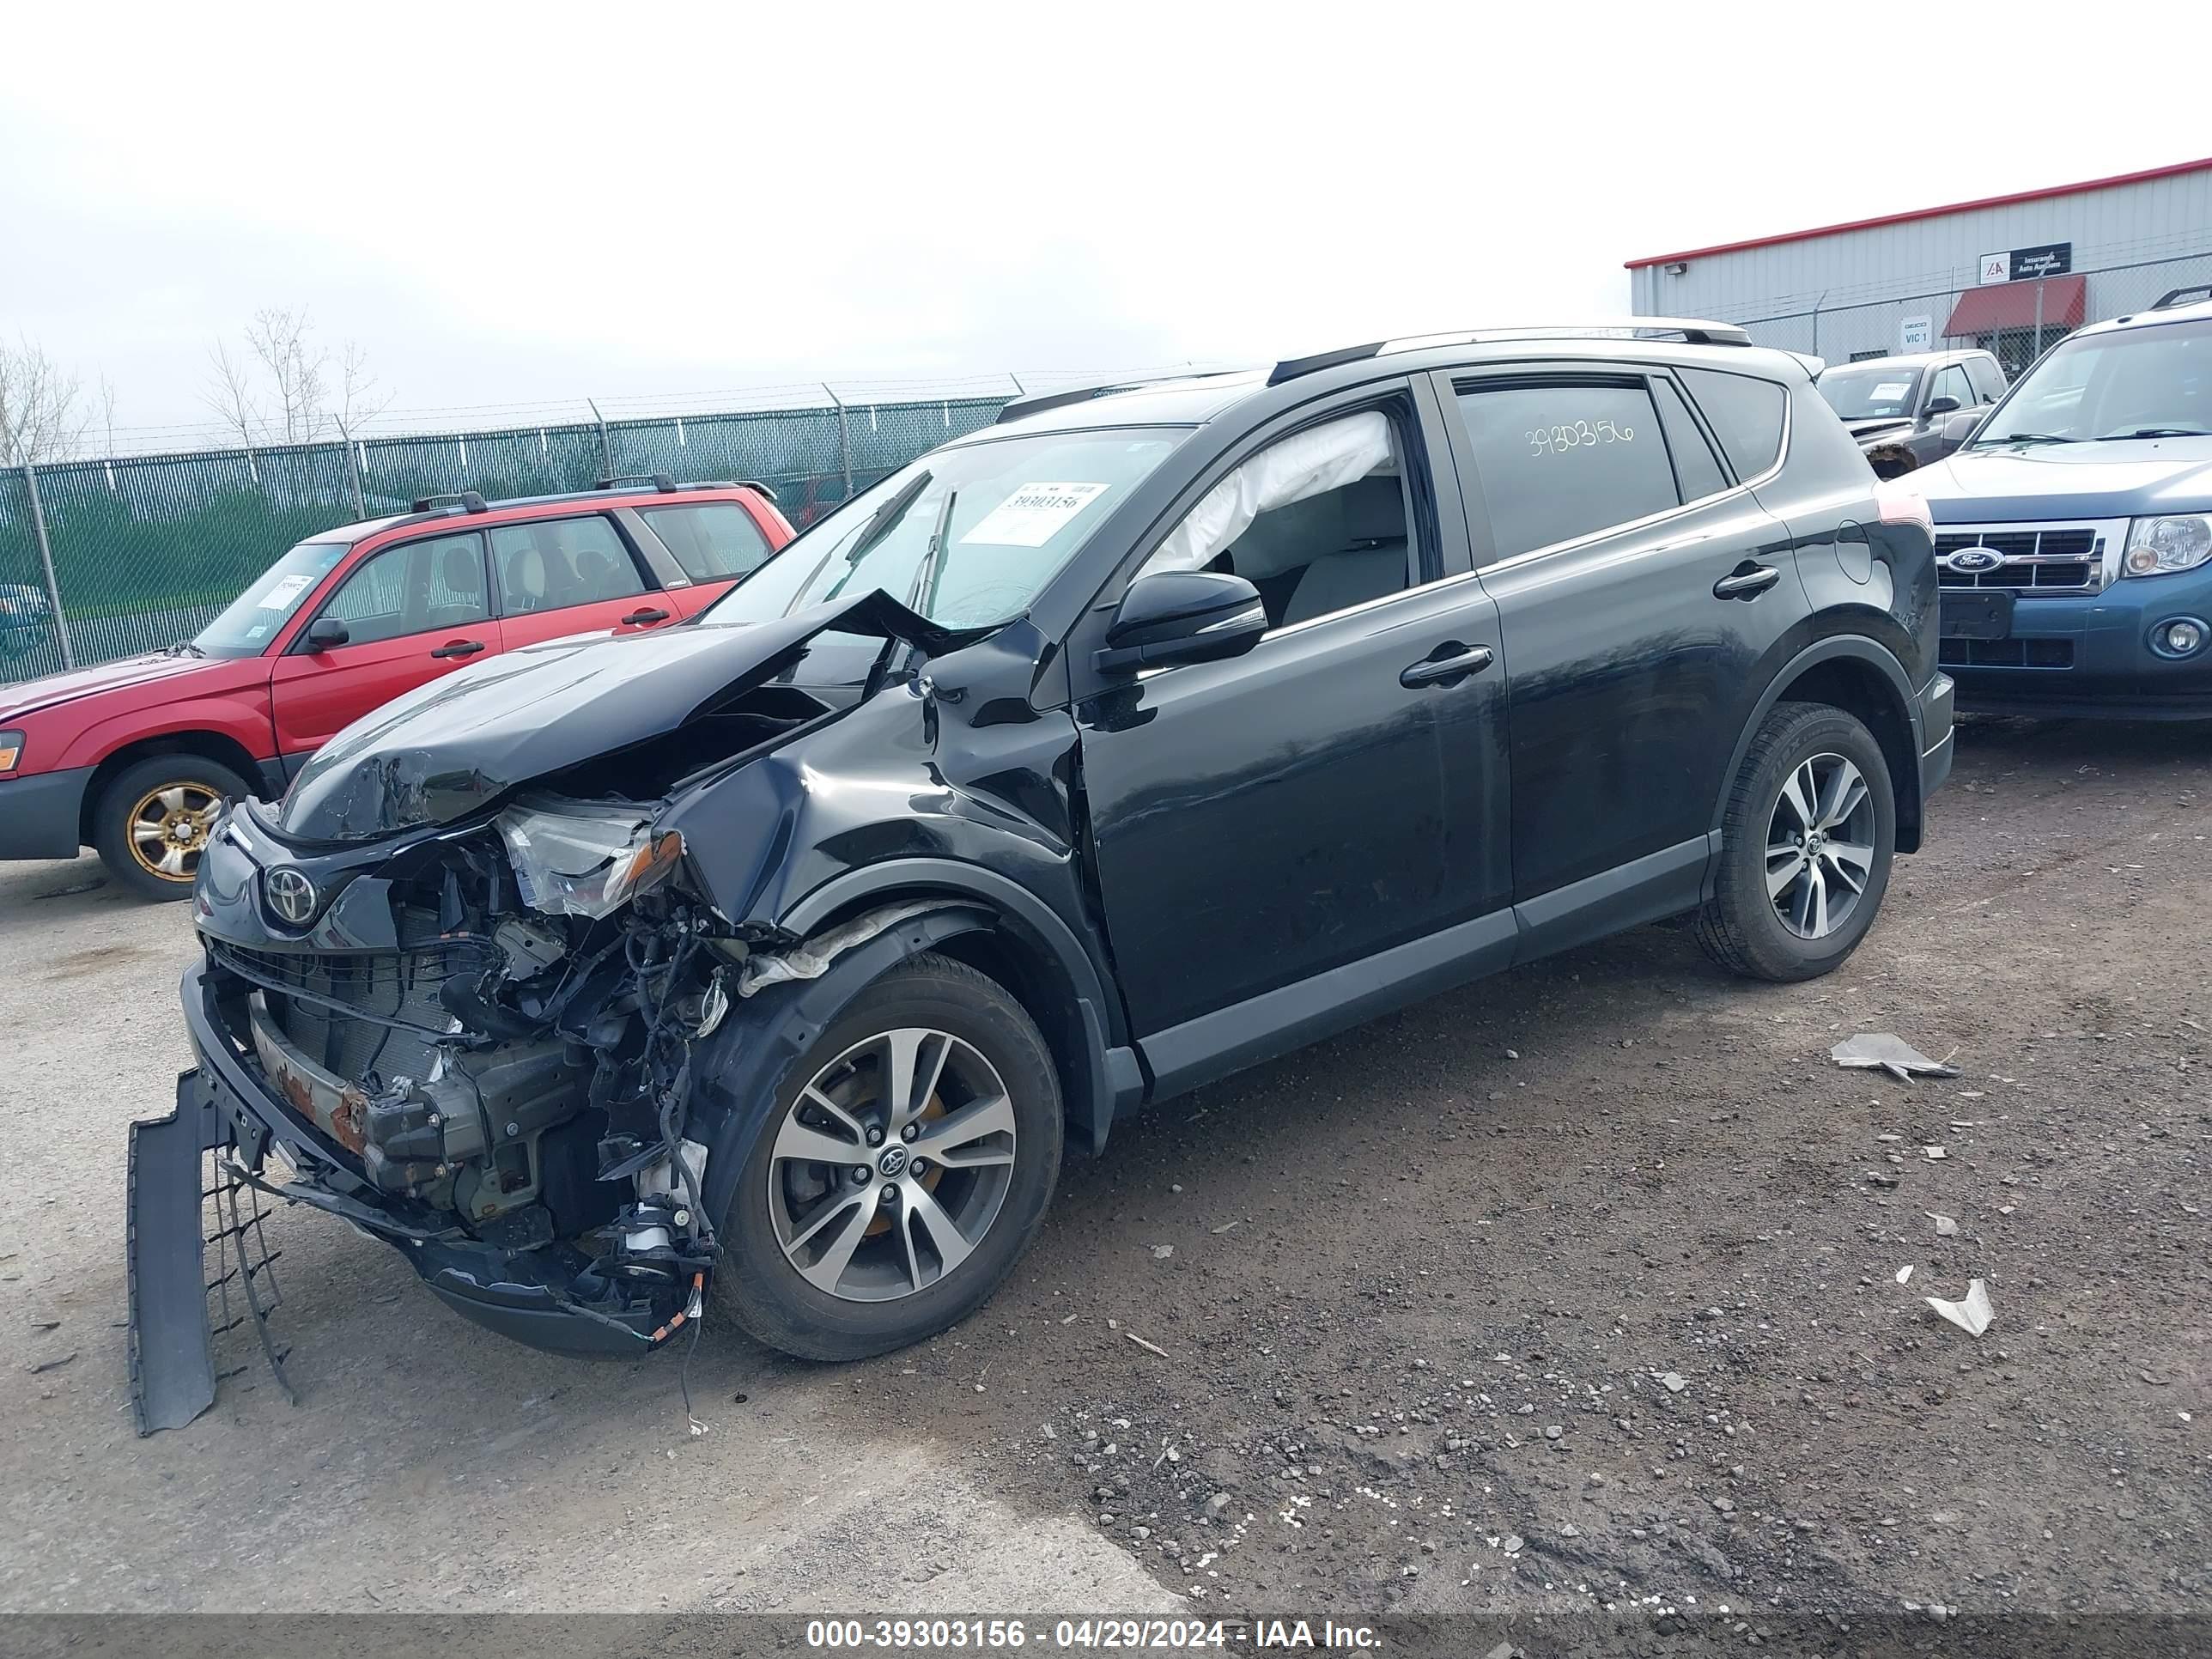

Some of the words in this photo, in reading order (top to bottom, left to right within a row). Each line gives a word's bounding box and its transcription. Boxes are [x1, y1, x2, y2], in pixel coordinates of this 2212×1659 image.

[2019, 264, 2033, 273] Auto
[1906, 333, 1920, 343] VIC
[1923, 332, 1927, 342] 1
[1525, 420, 1634, 457] 39303156
[1007, 495, 1081, 508] 39303156
[1959, 554, 1986, 566] Ford
